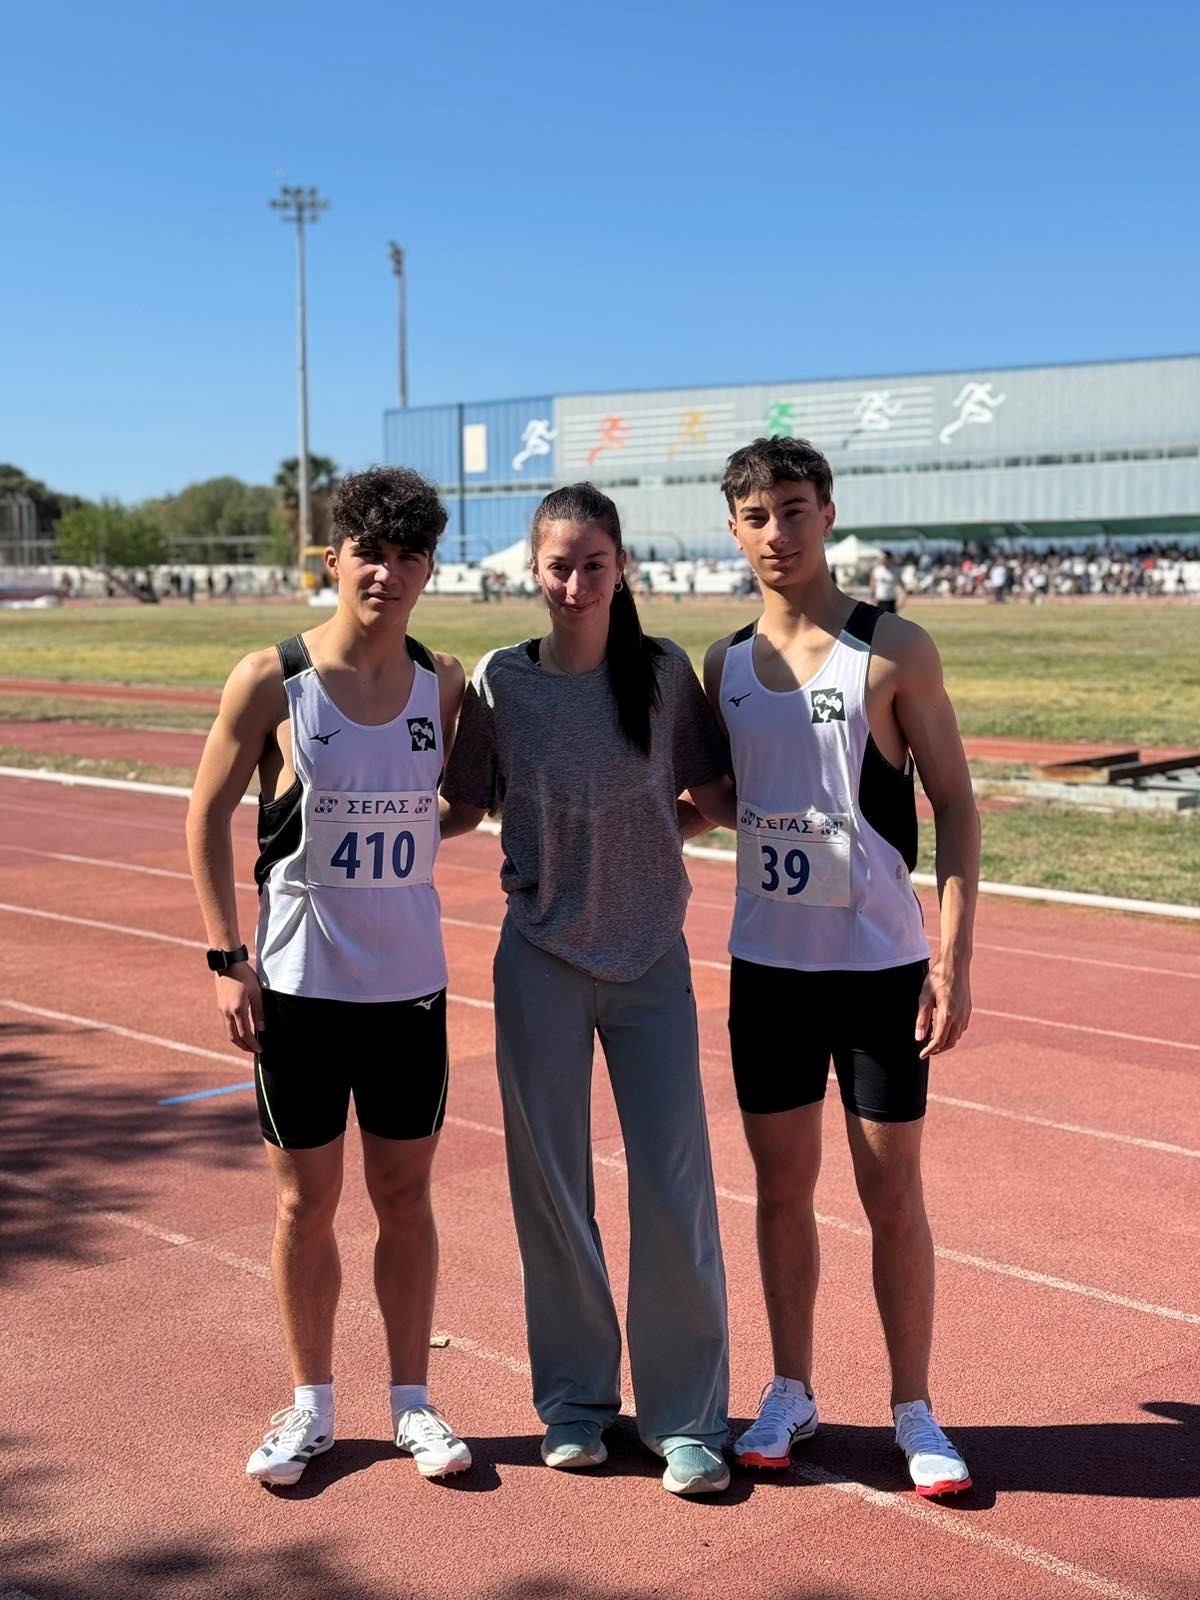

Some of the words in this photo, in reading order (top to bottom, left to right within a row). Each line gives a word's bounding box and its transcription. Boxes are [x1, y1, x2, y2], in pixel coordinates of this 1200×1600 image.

[346, 799, 409, 814] ΣΕΓΑΣ
[756, 817, 813, 833] ΣΕΓΑΣ
[330, 830, 416, 880] 410
[761, 845, 810, 896] 39
